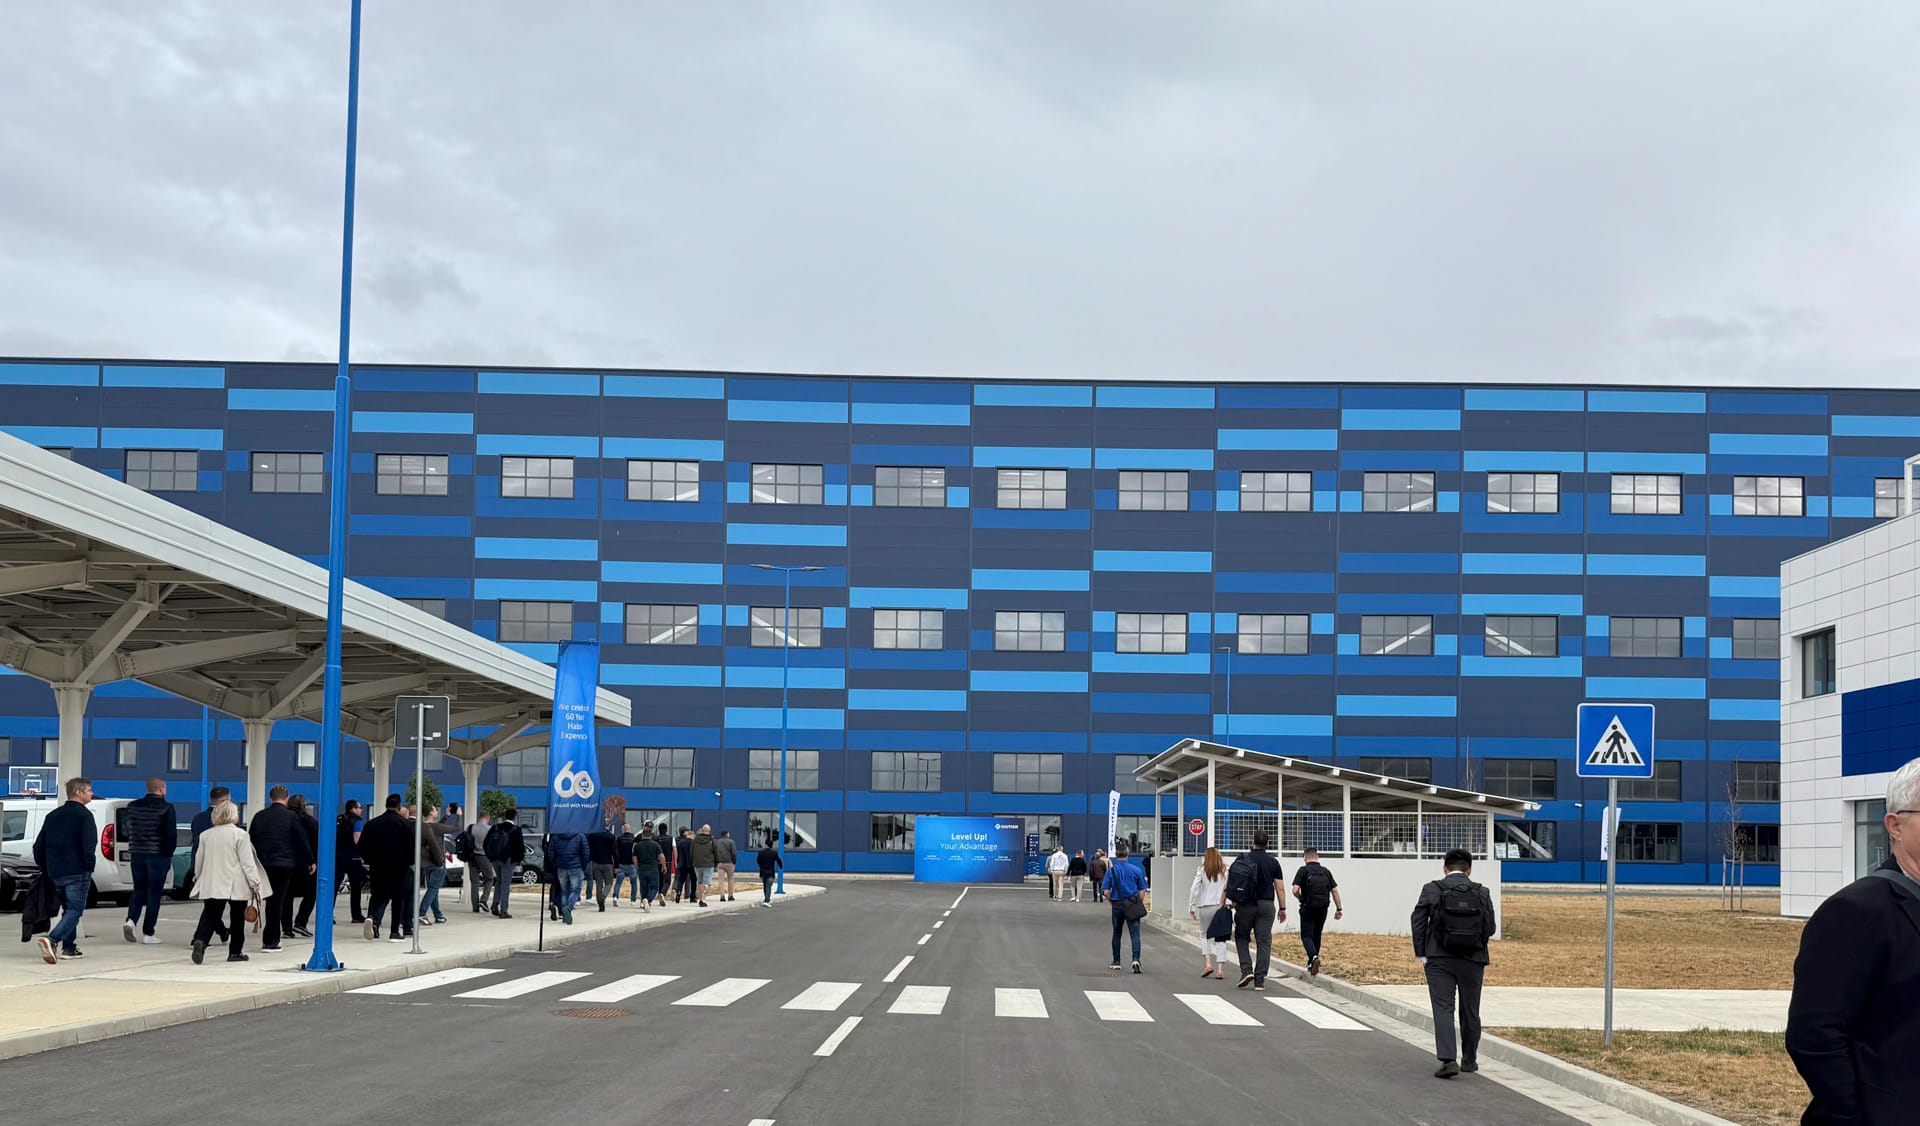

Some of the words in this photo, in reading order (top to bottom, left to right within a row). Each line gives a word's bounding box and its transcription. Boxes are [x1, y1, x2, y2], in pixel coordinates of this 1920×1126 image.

[565, 712, 574, 720] 60
[554, 760, 595, 799] 60
[951, 832, 972, 840] Level
[974, 832, 988, 842] Up!
[940, 842, 958, 850] Your
[959, 842, 998, 852] Advantage
